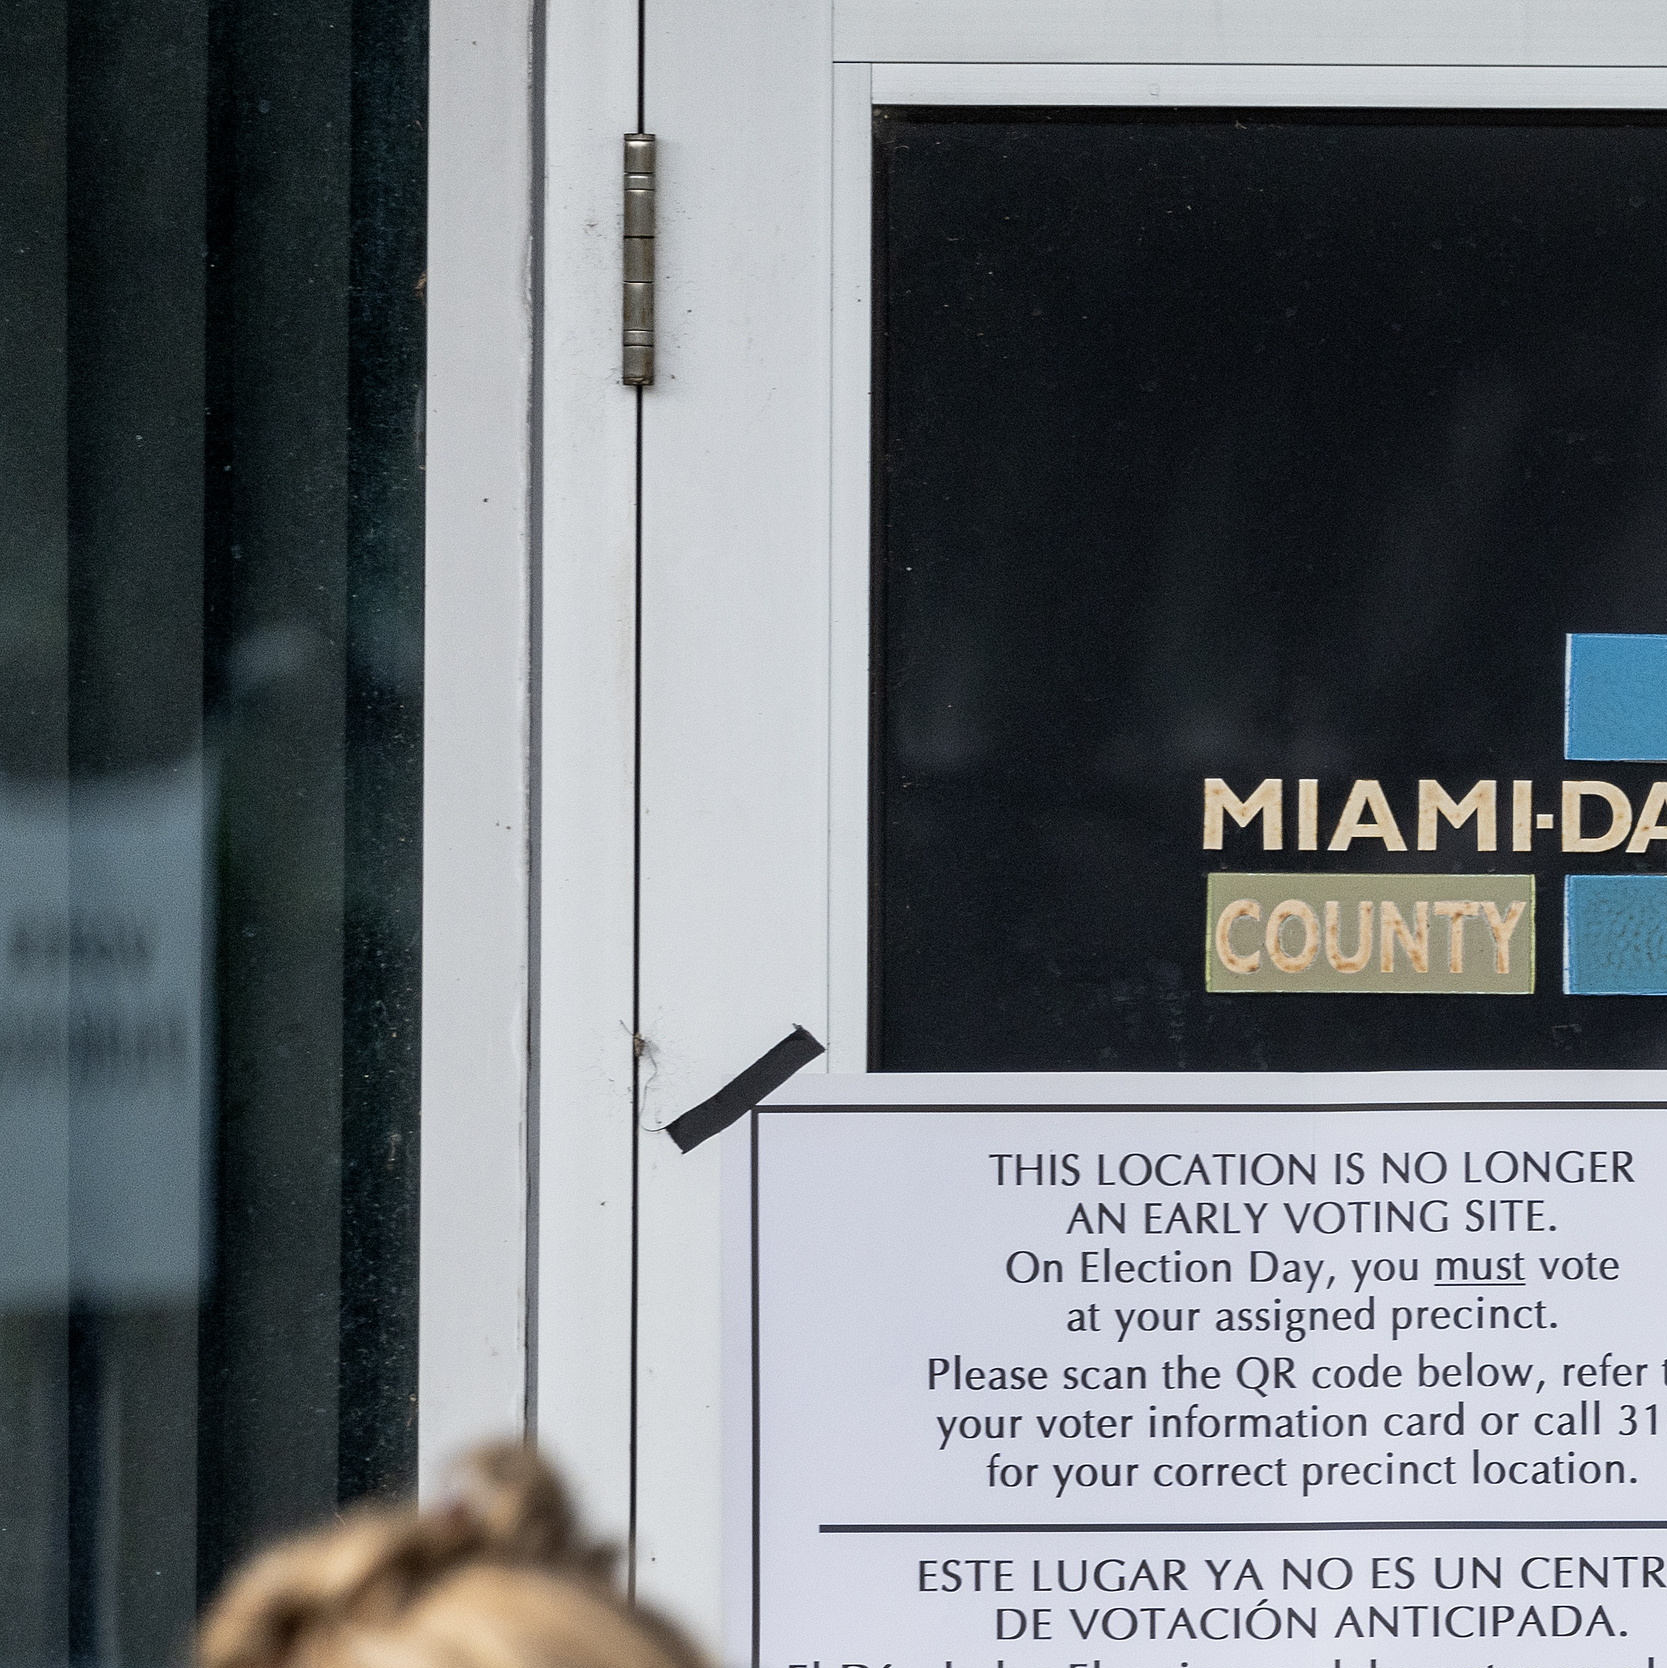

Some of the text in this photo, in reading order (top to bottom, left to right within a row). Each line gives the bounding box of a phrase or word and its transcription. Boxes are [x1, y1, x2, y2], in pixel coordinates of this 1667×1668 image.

[1215, 900, 1527, 974] COUNTY
[989, 1151, 1635, 1186] THIS LOCATION IS NO LONGER
[1066, 1200, 1556, 1234] AN EARLY VOTING SITE.
[1006, 1248, 1619, 1293] On Election Day, you must vote
[929, 1355, 1048, 1390] Please
[1063, 1367, 1146, 1390] scan
[1162, 1355, 1221, 1389] the
[1236, 1357, 1297, 1397] QR
[1312, 1354, 1402, 1389] code
[1419, 1352, 1545, 1394] below,
[1564, 1353, 1648, 1387] refer
[919, 1560, 1014, 1592] ESTE
[1034, 1559, 1188, 1592] LUGAR
[1204, 1559, 1264, 1590] YA
[1283, 1558, 1353, 1590] NO
[1372, 1557, 1415, 1589] ES
[1435, 1557, 1501, 1589] UN
